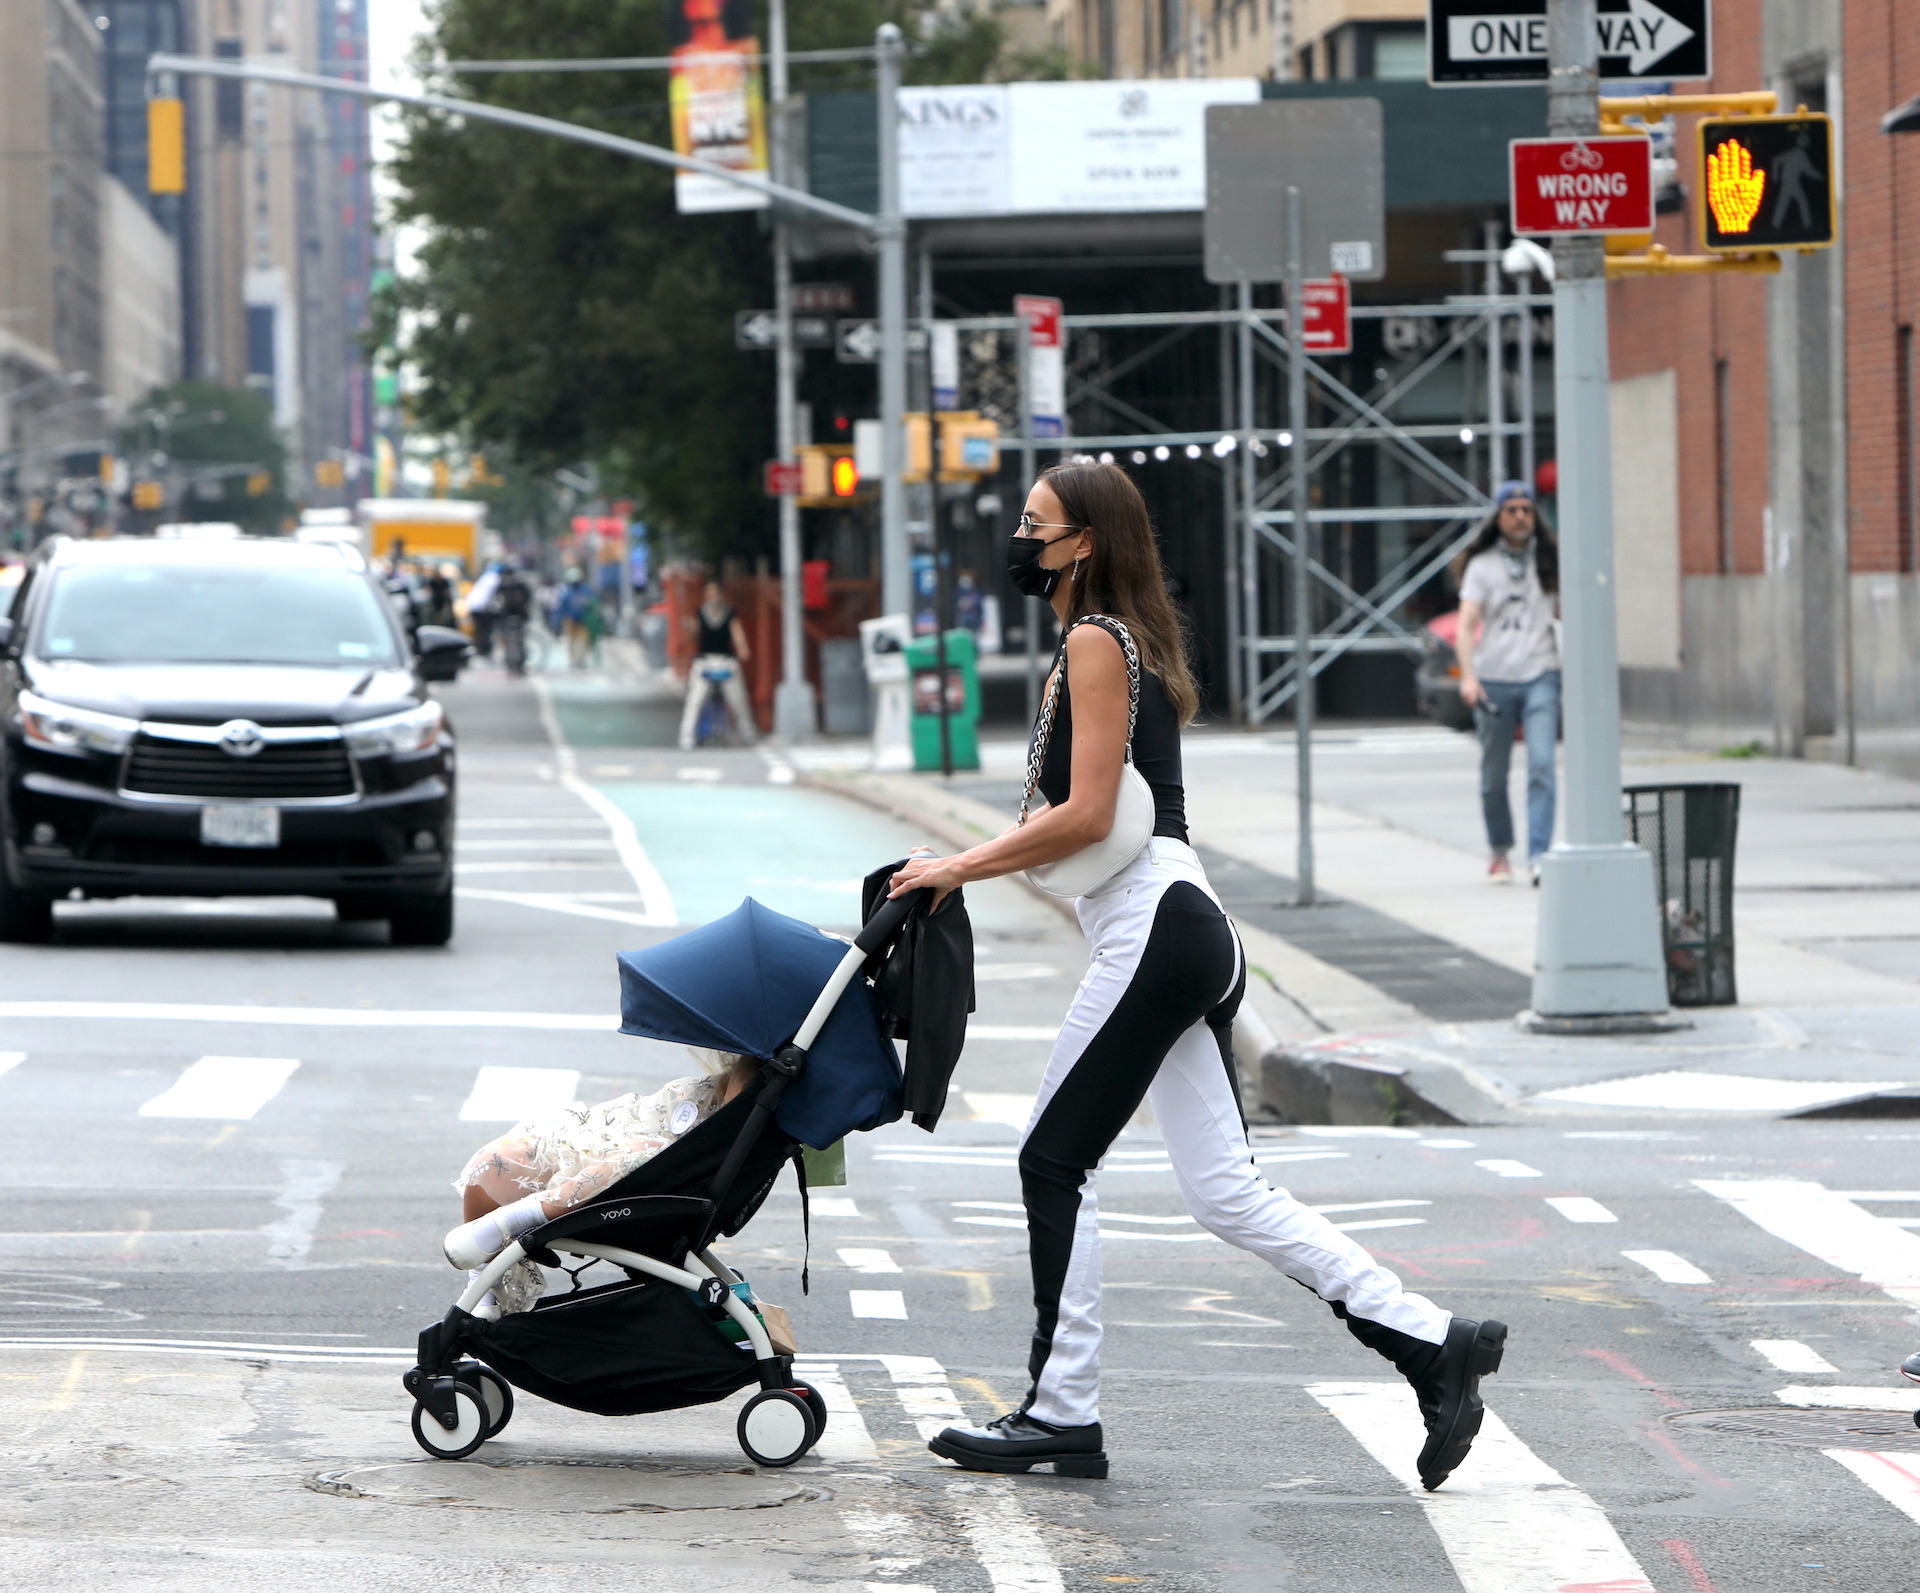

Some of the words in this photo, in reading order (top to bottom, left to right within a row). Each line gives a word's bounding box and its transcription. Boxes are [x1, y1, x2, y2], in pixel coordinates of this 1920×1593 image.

[1472, 20, 1548, 54] ONE
[1537, 172, 1628, 198] WRONG
[1555, 199, 1610, 223] WAY
[600, 1207, 631, 1220] YOYO
